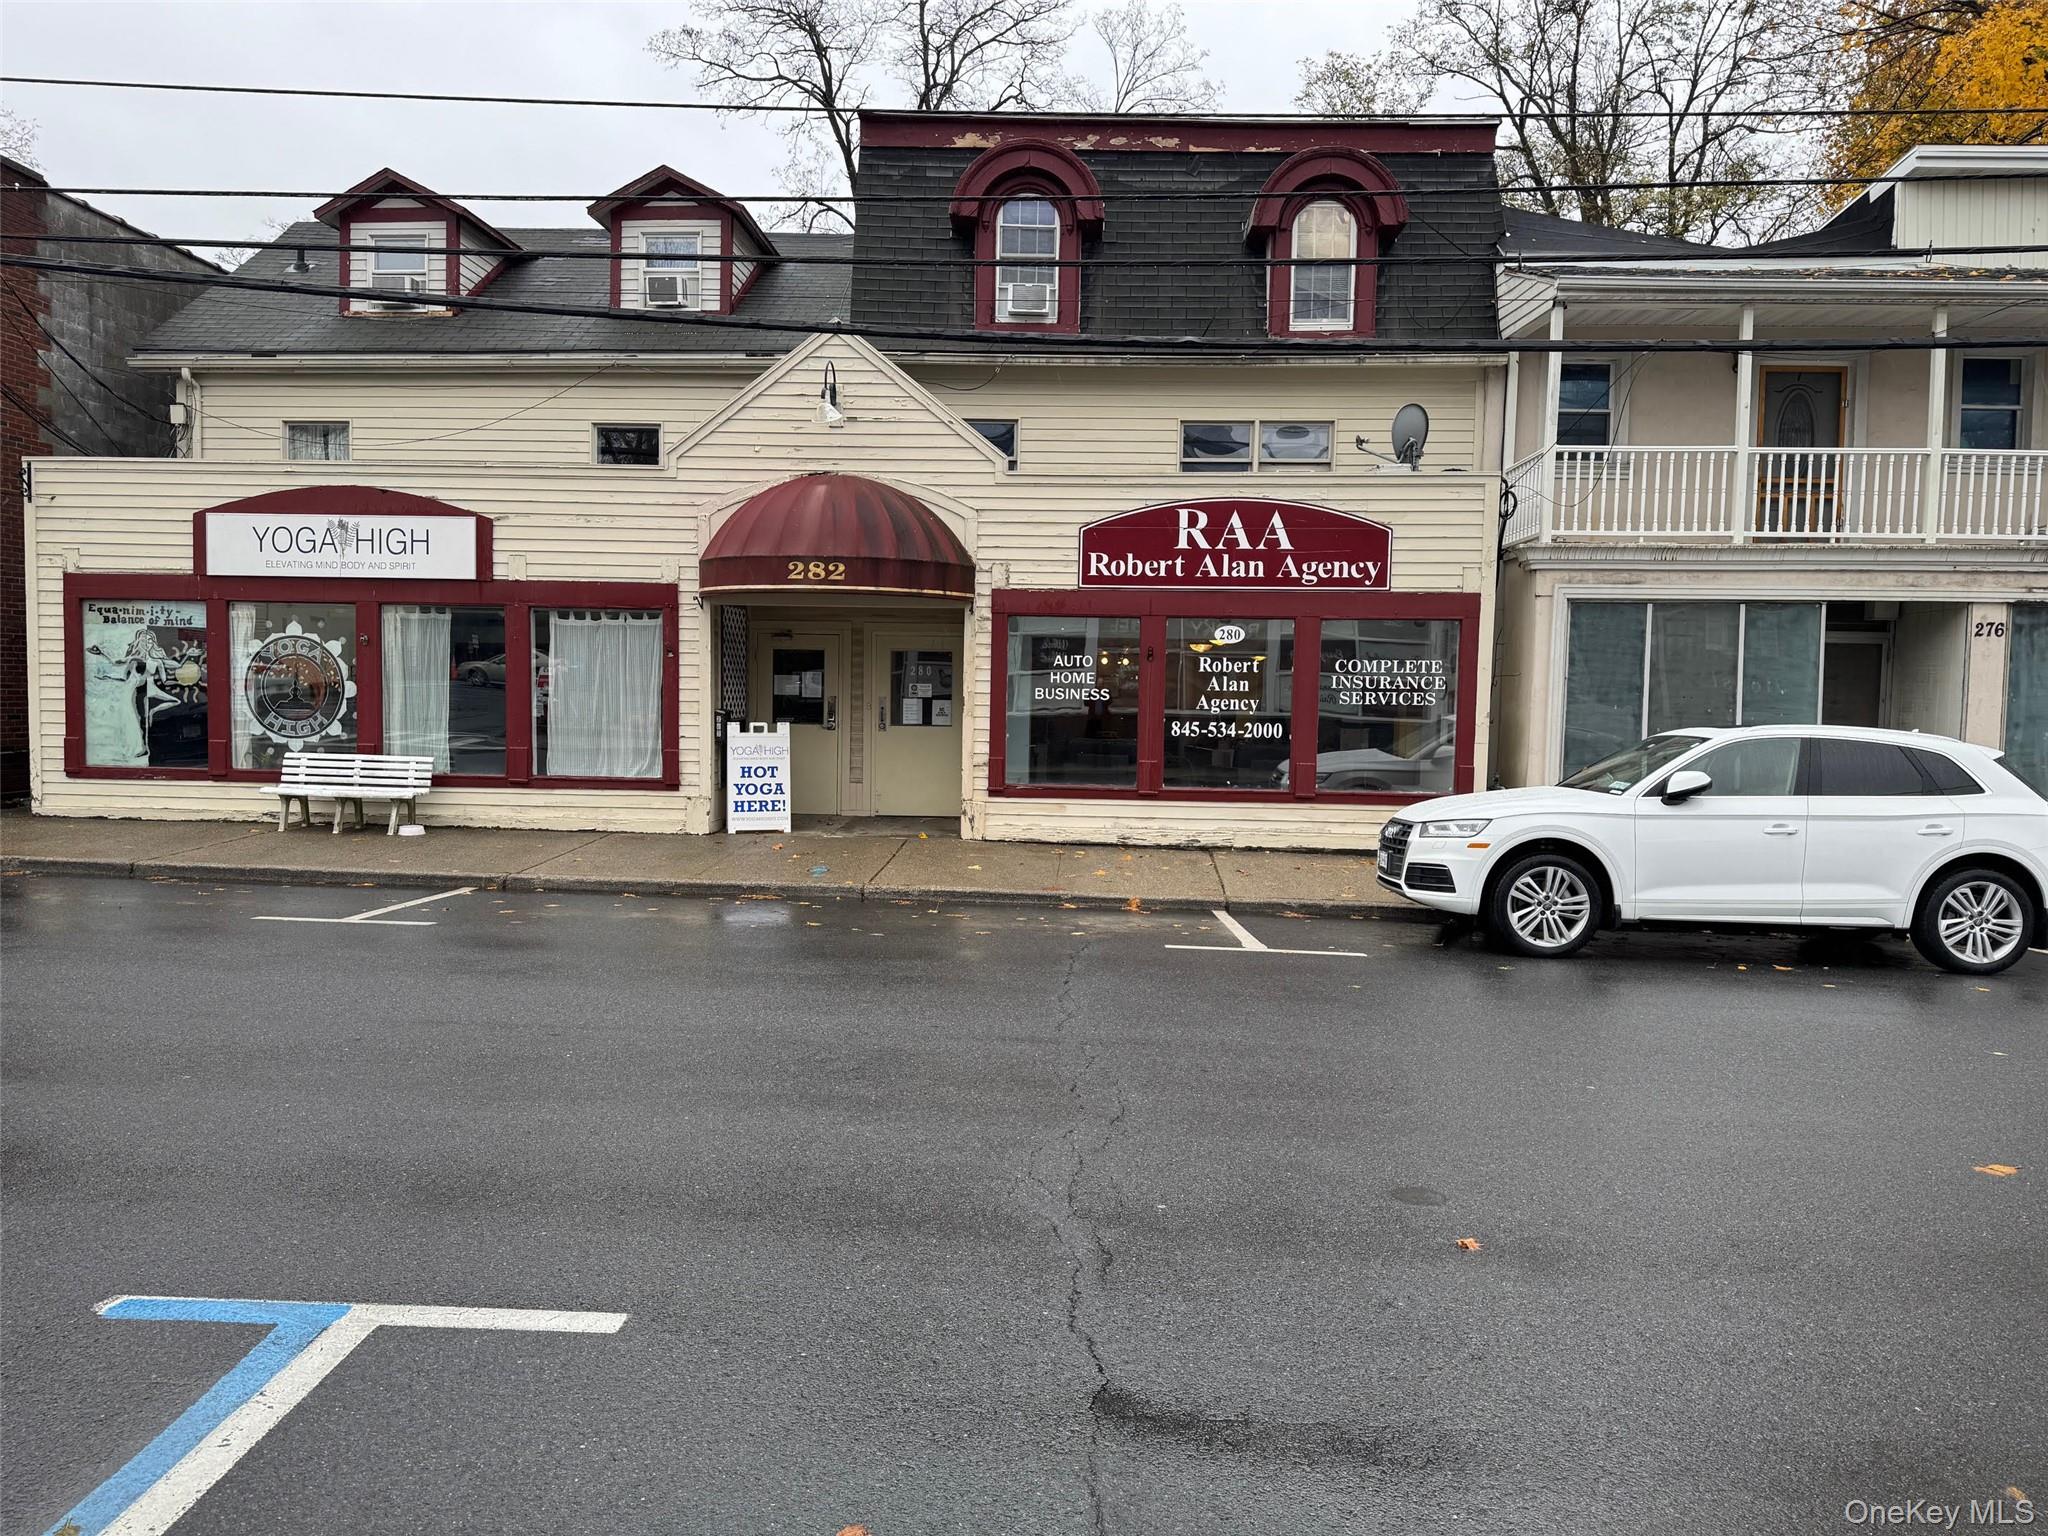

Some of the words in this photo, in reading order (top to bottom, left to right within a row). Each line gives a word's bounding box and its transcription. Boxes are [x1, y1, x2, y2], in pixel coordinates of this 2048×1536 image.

[1174, 508, 1294, 550] RAA
[252, 526, 339, 555] YOGA
[355, 527, 431, 555] HIGH
[265, 559, 313, 569] ELEVATING
[315, 560, 338, 570] MIND
[340, 561, 365, 570] BODY
[368, 561, 387, 570] AND
[389, 561, 416, 571] SPIRIT
[787, 561, 846, 580] 282
[1088, 552, 1185, 577] Robert
[1195, 553, 1264, 577] Alan
[1277, 554, 1381, 585] Agency
[102, 614, 145, 624] Balance
[148, 616, 161, 625] of
[163, 615, 193, 626] mind
[1219, 628, 1241, 640] 280
[1974, 622, 2005, 638] 276
[260, 639, 323, 665] YOGA
[1053, 655, 1093, 667] AUTO
[1198, 656, 1260, 673] Robert
[1335, 659, 1443, 674] COMPLETE
[910, 665, 932, 676] 280
[1050, 671, 1096, 684] HOME
[1206, 675, 1249, 692] Alan
[1330, 675, 1447, 690] INSURANCE
[1034, 687, 1110, 701] BUSINESS
[1339, 691, 1436, 706] SERVICES
[1195, 694, 1260, 714] Agency
[264, 711, 328, 735] HIGH
[1171, 720, 1283, 739] 845-534-2000
[730, 746, 760, 756] YOGA
[763, 746, 789, 756] HIGH
[740, 766, 779, 778] HOT
[733, 783, 785, 795] YOGA
[733, 800, 786, 813] HERE!
